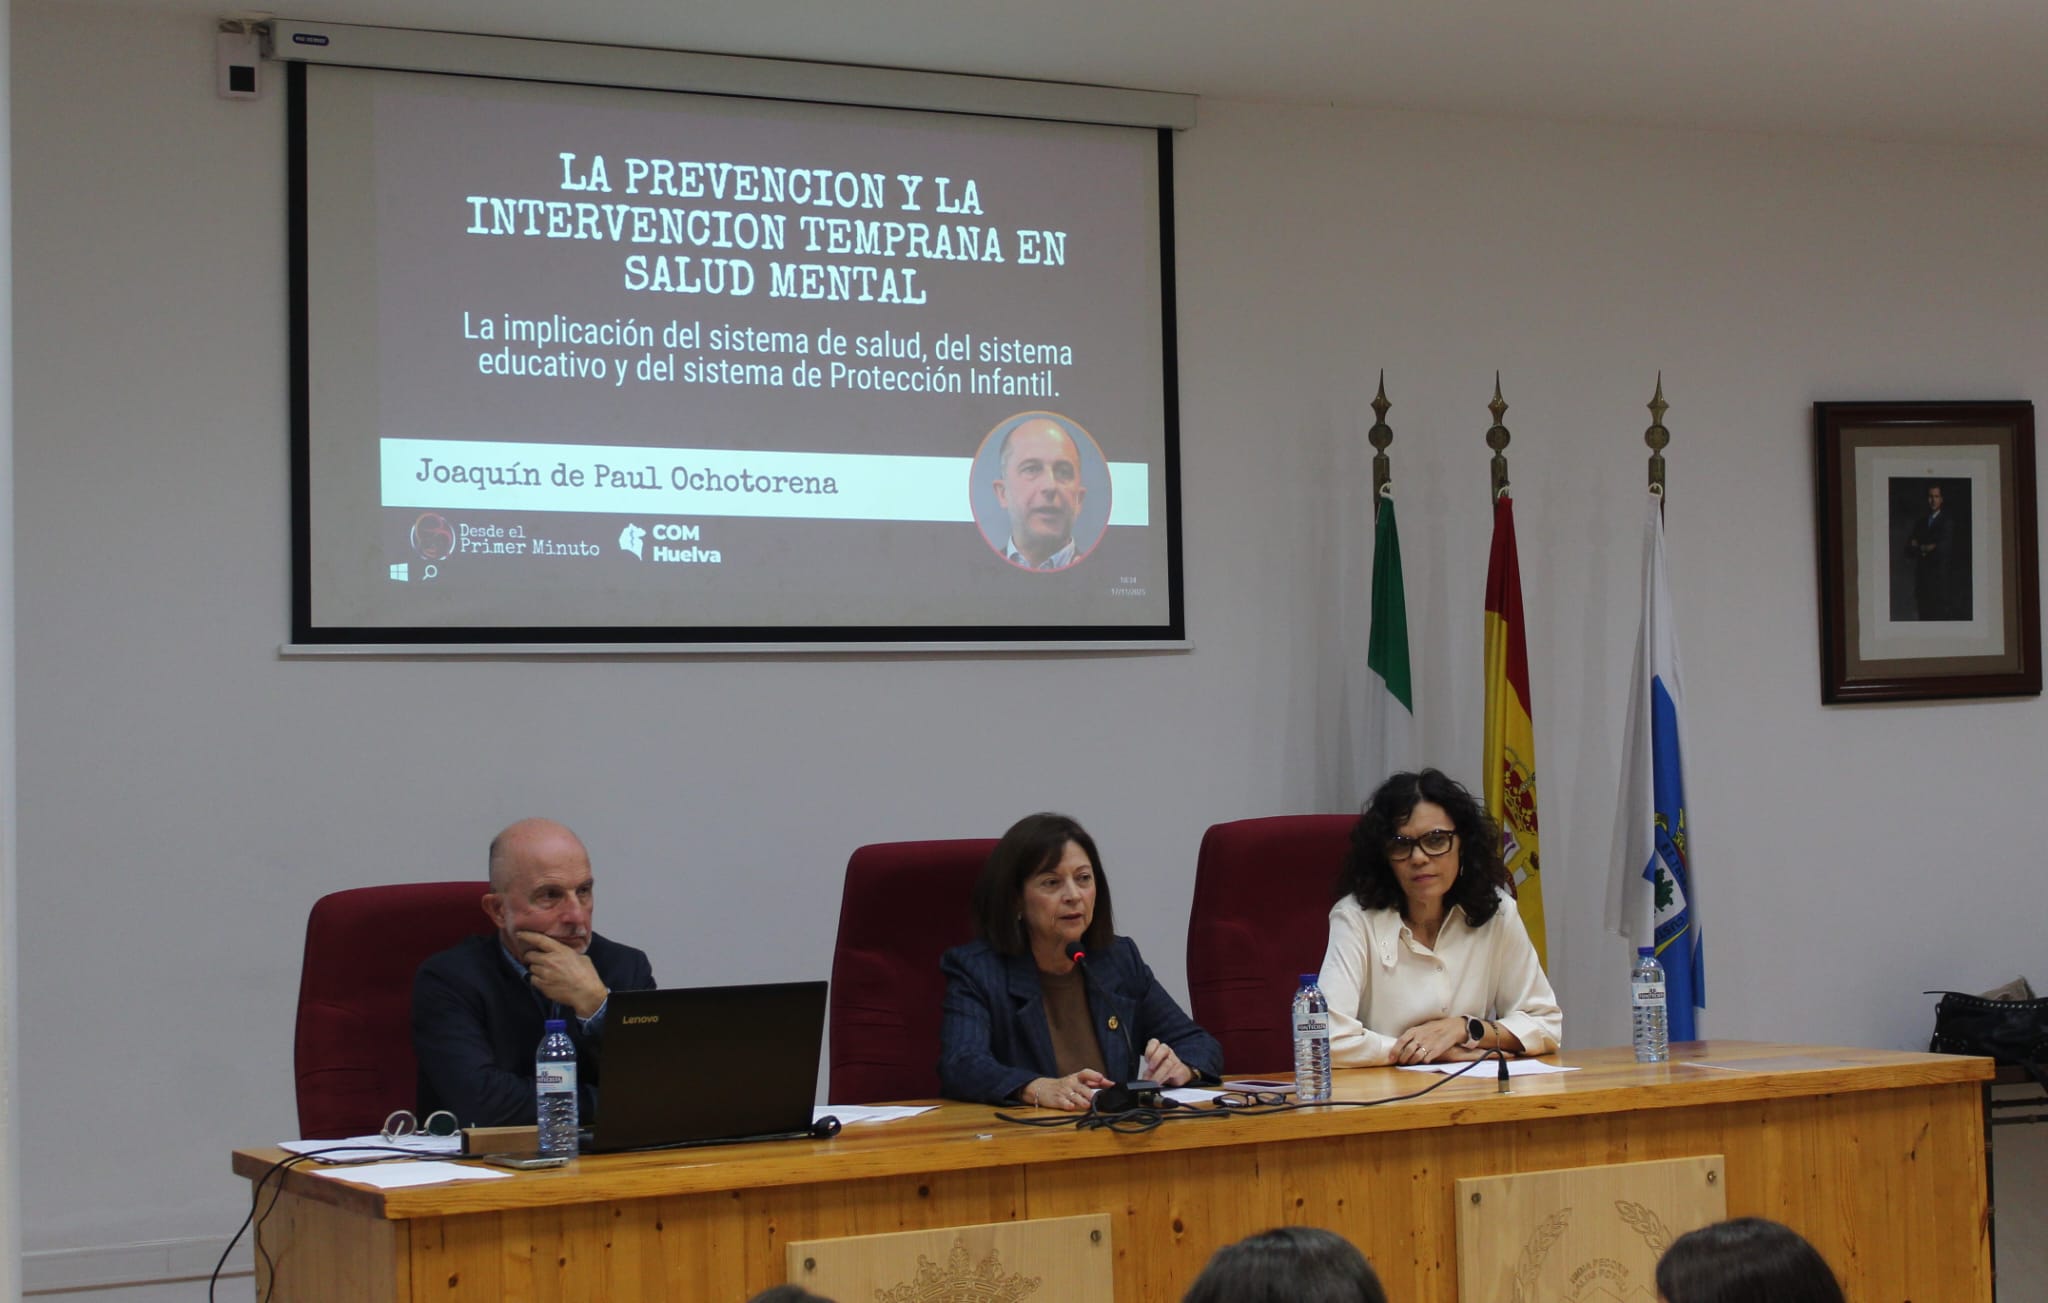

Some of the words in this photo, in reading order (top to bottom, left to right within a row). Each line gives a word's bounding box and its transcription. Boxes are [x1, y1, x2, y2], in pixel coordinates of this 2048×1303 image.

[559, 152, 612, 193] LA
[624, 157, 886, 209] PREVENCION
[896, 174, 924, 211] Y
[934, 176, 985, 216] LA
[466, 195, 787, 251] INTERVENCION
[799, 215, 1006, 263] TEMPRANA
[1016, 229, 1067, 266] EN
[624, 254, 755, 297] SALUD
[769, 261, 927, 305] MENTAL
[463, 311, 495, 341] La
[503, 313, 655, 349] implicación
[662, 319, 701, 350] del
[709, 324, 810, 354] sistema
[817, 327, 848, 356] de
[855, 330, 929, 364] salud,
[935, 333, 972, 361] del
[979, 336, 1074, 366] sistema
[478, 346, 608, 380] educativo
[614, 358, 629, 388] y
[636, 352, 675, 382] del
[683, 355, 784, 387] sistema
[791, 359, 823, 388] de
[830, 361, 962, 394] Protección
[970, 367, 1061, 398] Infantil.
[415, 458, 543, 491] Joaquín
[550, 463, 586, 488] de
[594, 463, 664, 491] Paul
[671, 466, 840, 496] Ochotorena
[459, 523, 505, 539] Desde
[508, 525, 527, 539] el
[459, 538, 527, 556] Primer
[532, 540, 600, 557] Minuto
[652, 524, 700, 541] COM
[652, 547, 722, 563] Huelva
[622, 1015, 660, 1025] Lenovo
